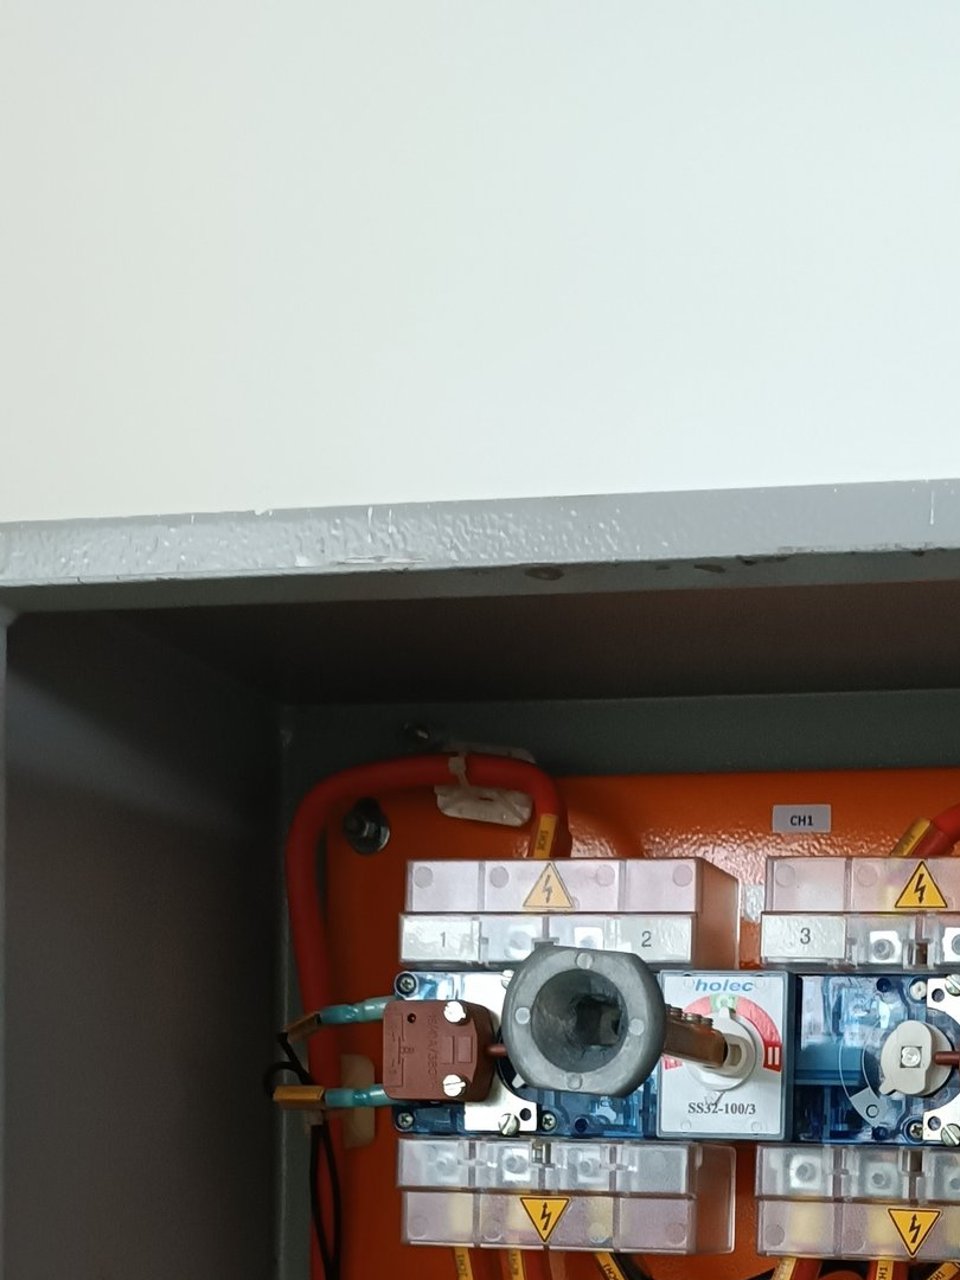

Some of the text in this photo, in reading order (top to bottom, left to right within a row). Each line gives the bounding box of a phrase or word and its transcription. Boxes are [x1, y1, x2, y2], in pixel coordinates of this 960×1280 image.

[790, 815, 814, 826] CH1
[440, 931, 446, 947] 1
[641, 931, 652, 947] 2
[800, 928, 811, 944] 3
[695, 979, 753, 992] holec
[688, 1102, 756, 1115] SS32-100/3
